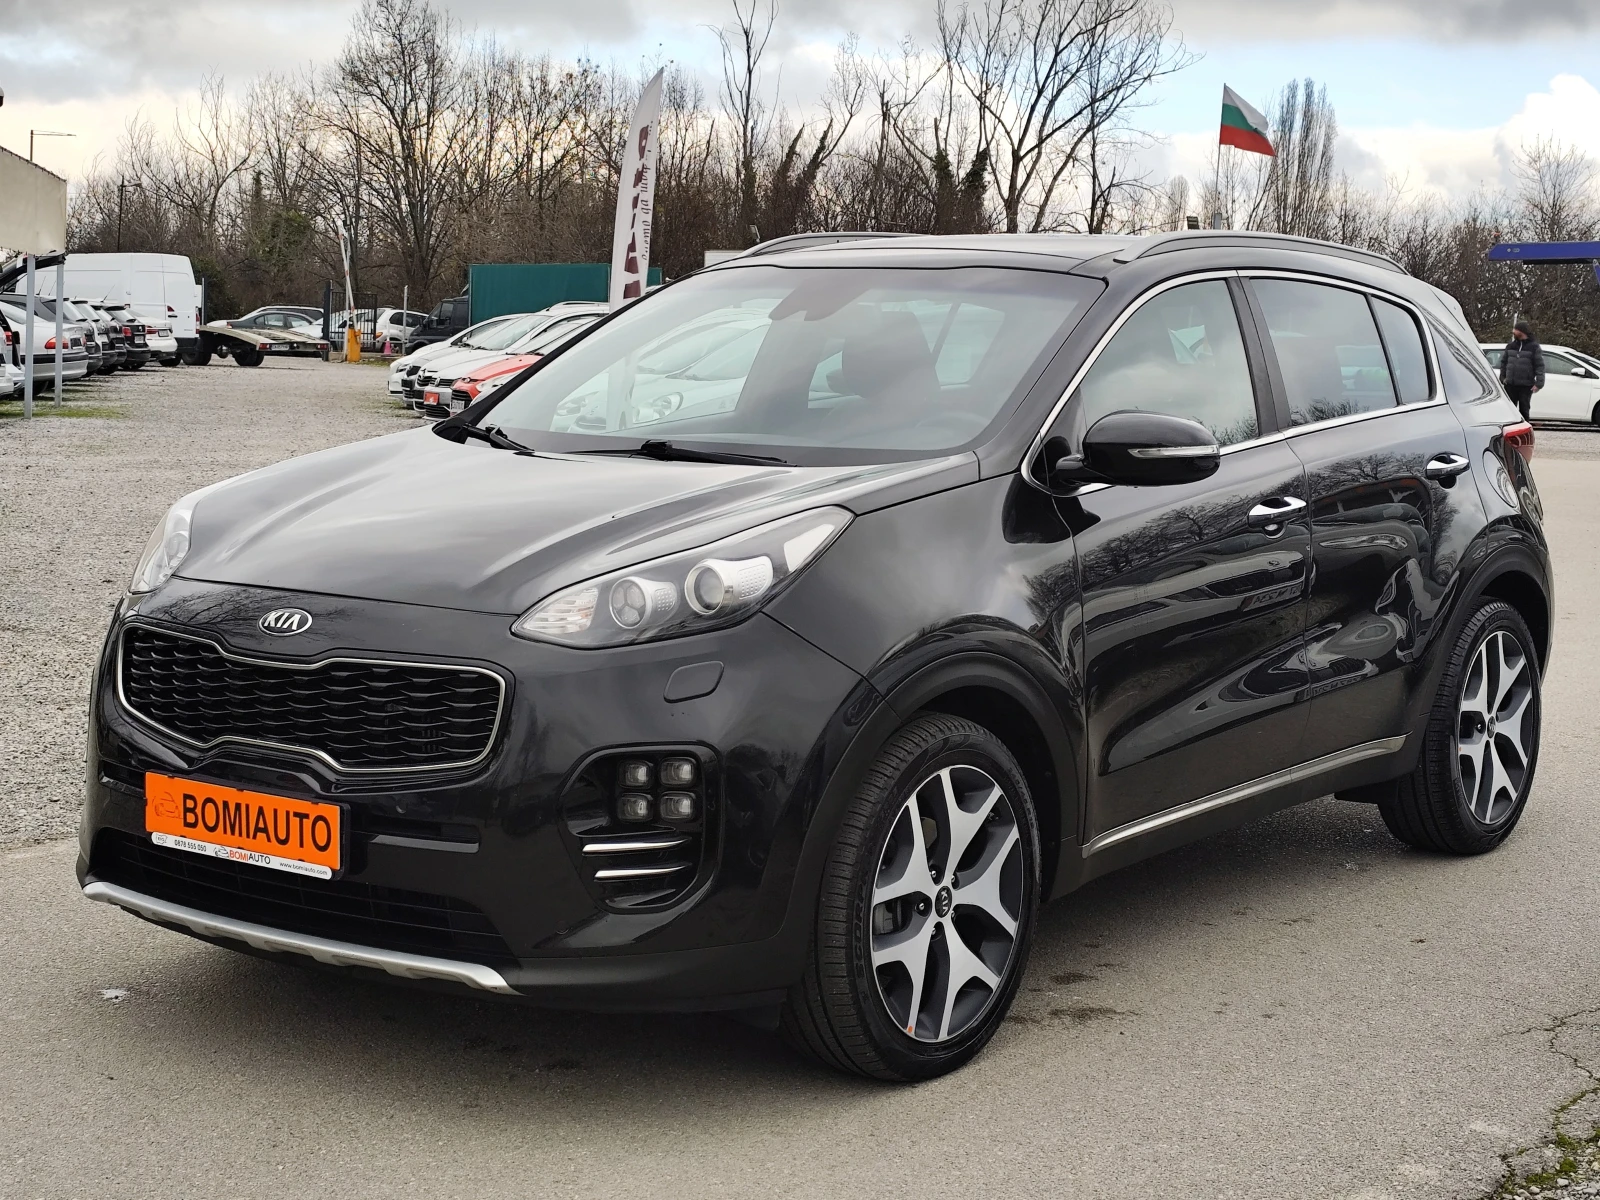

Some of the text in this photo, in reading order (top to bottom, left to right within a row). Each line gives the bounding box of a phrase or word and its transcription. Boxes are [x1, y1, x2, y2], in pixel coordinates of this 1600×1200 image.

[263, 611, 302, 631] KIA
[182, 792, 332, 853] BOMIAUTO
[174, 839, 207, 852] 0878 555 050
[229, 844, 271, 865] BOMIAUTO
[279, 862, 328, 876] www.bomiauto.com
[940, 889, 949, 915] KIA
